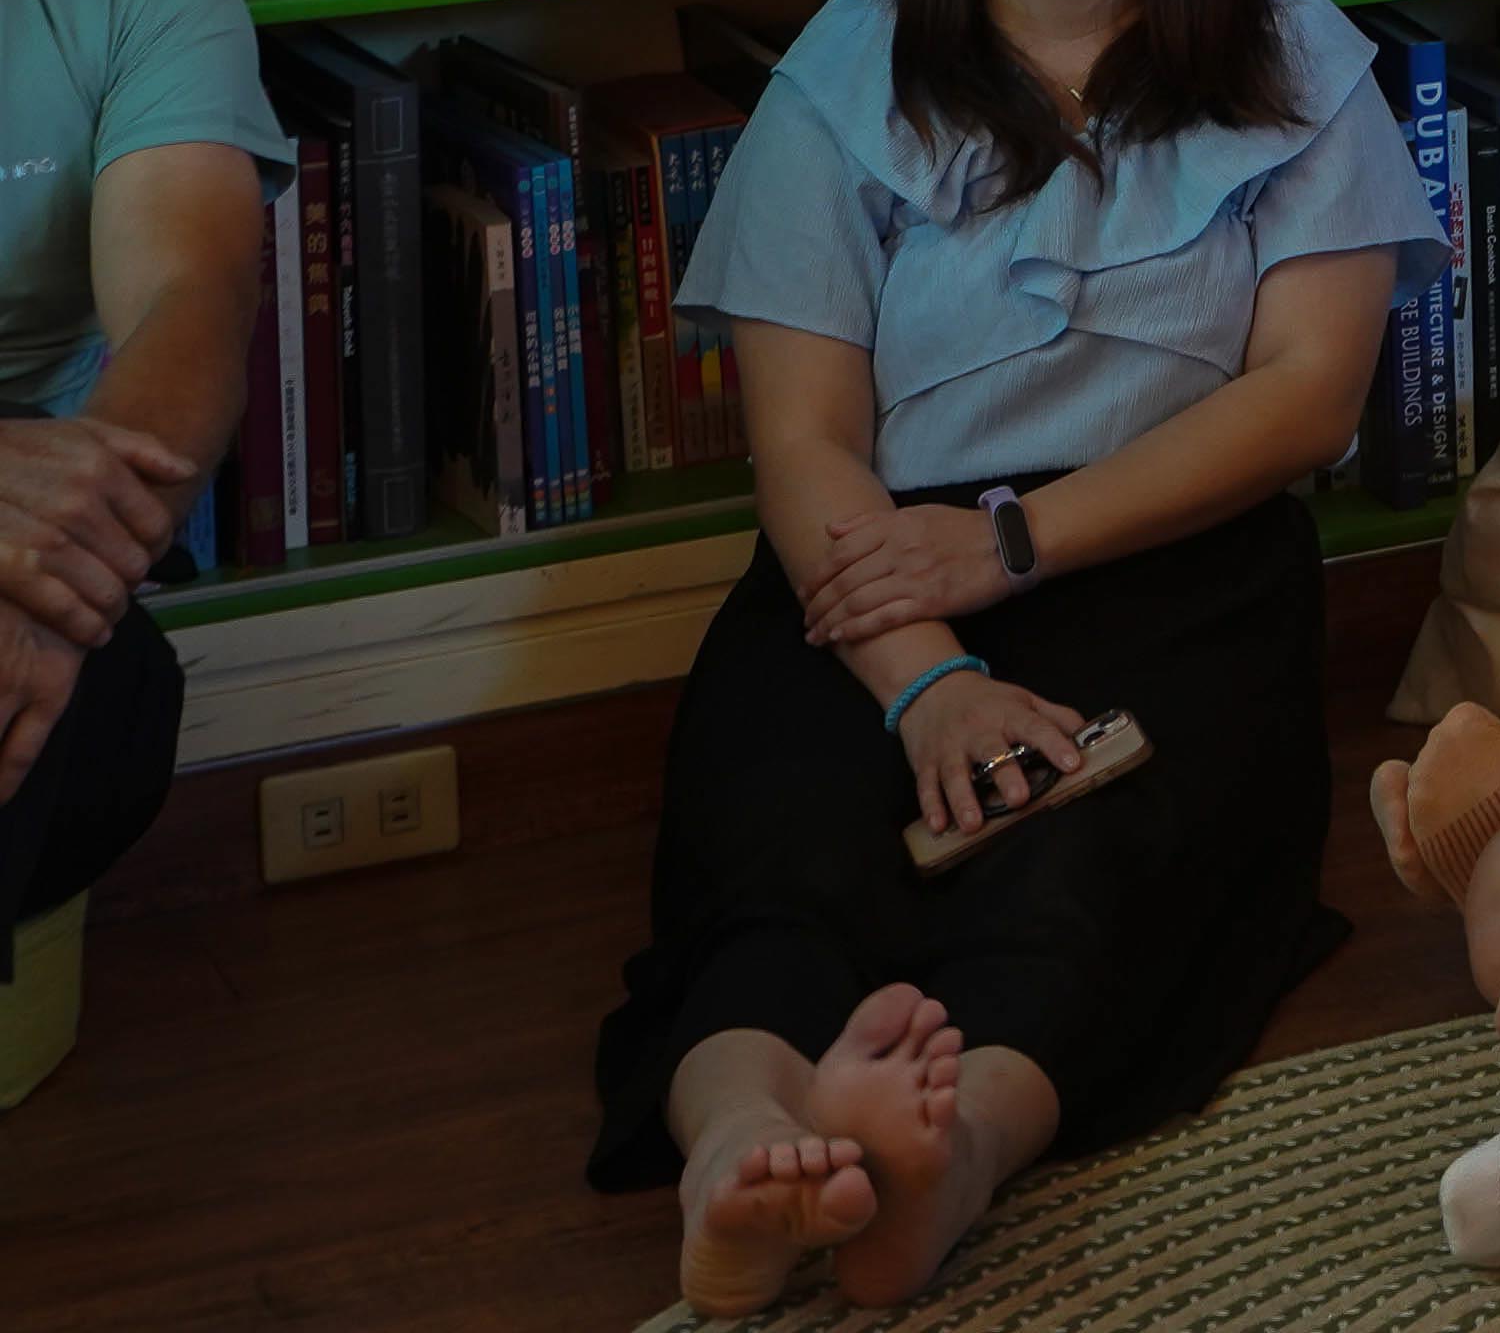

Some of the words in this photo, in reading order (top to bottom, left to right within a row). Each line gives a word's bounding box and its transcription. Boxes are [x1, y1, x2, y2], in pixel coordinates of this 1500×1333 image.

[1487, 235, 1498, 286] Cookbook
[1400, 324, 1423, 427] BUILDINGS
[1430, 392, 1448, 461] DESIGN
